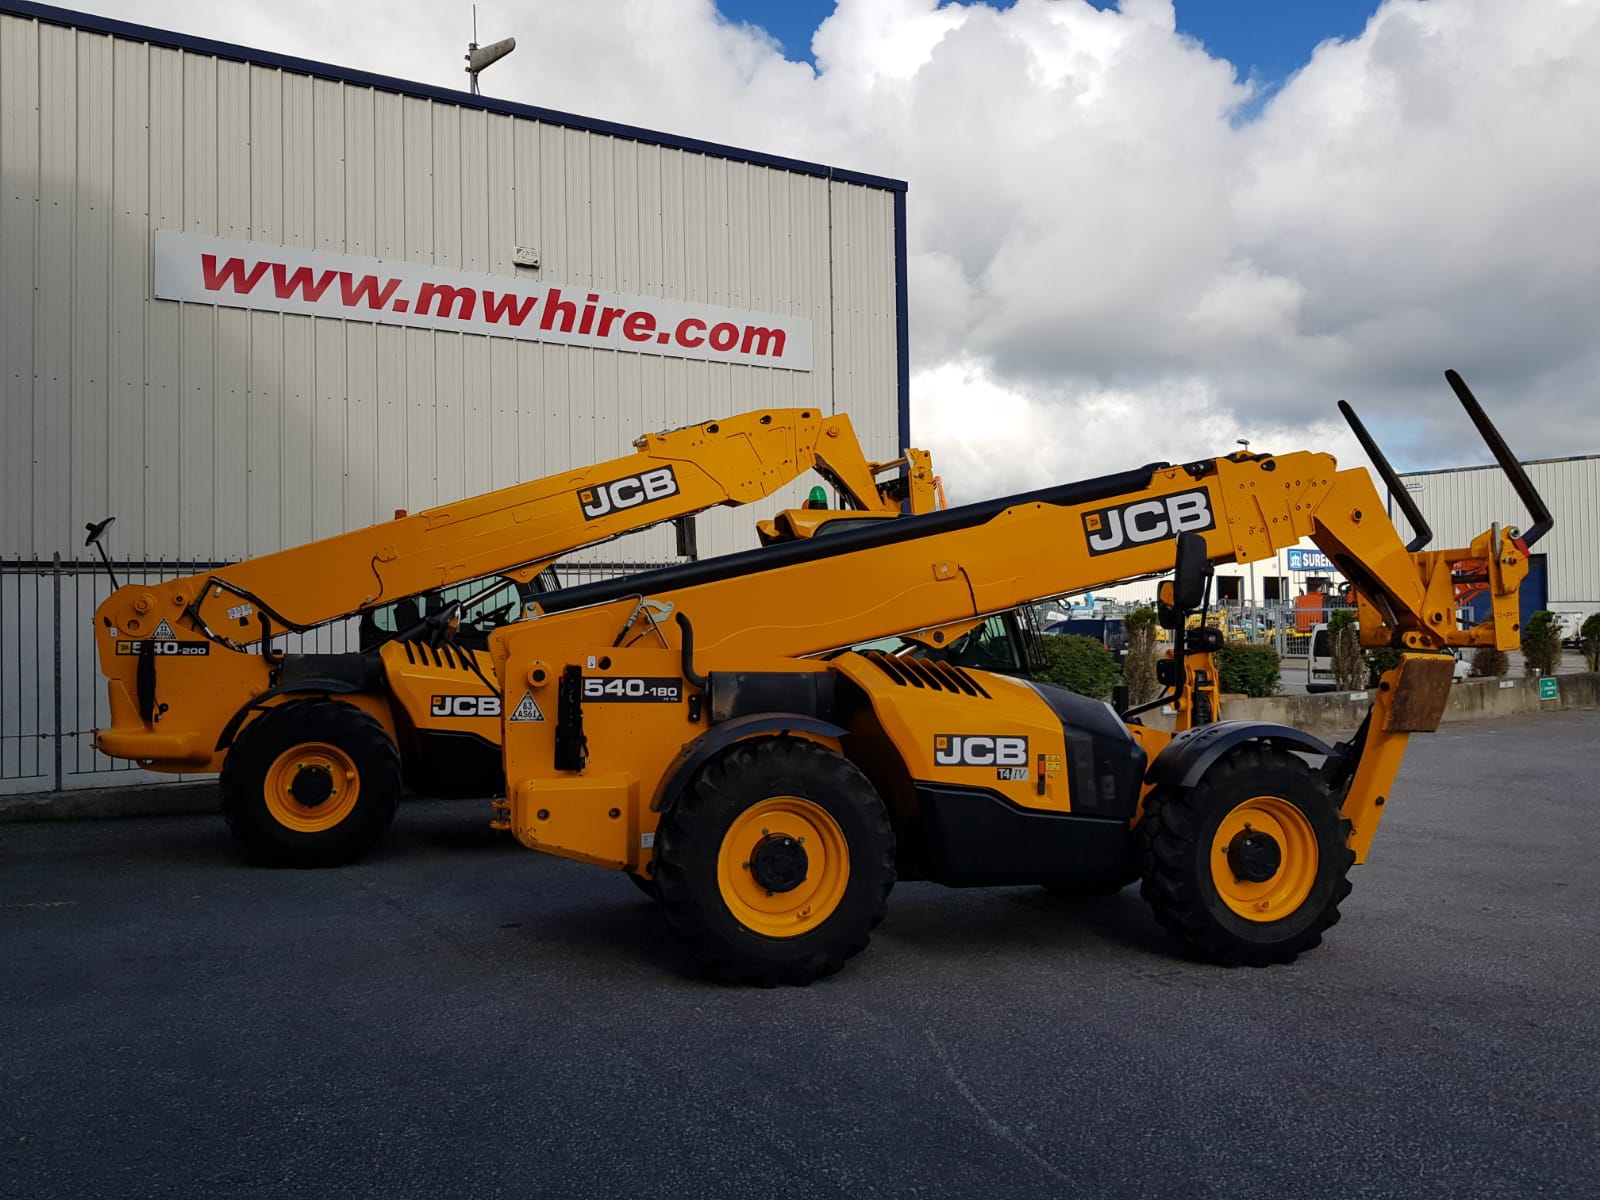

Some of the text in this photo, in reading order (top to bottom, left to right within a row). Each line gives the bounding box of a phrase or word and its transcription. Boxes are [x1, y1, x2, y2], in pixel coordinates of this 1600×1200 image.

[200, 252, 787, 359] www.mwhire.com
[585, 468, 677, 517] JCB
[1090, 491, 1212, 552] JCB
[432, 696, 501, 716] JCB
[584, 678, 678, 697] 540-180
[936, 736, 1027, 765] JCB
